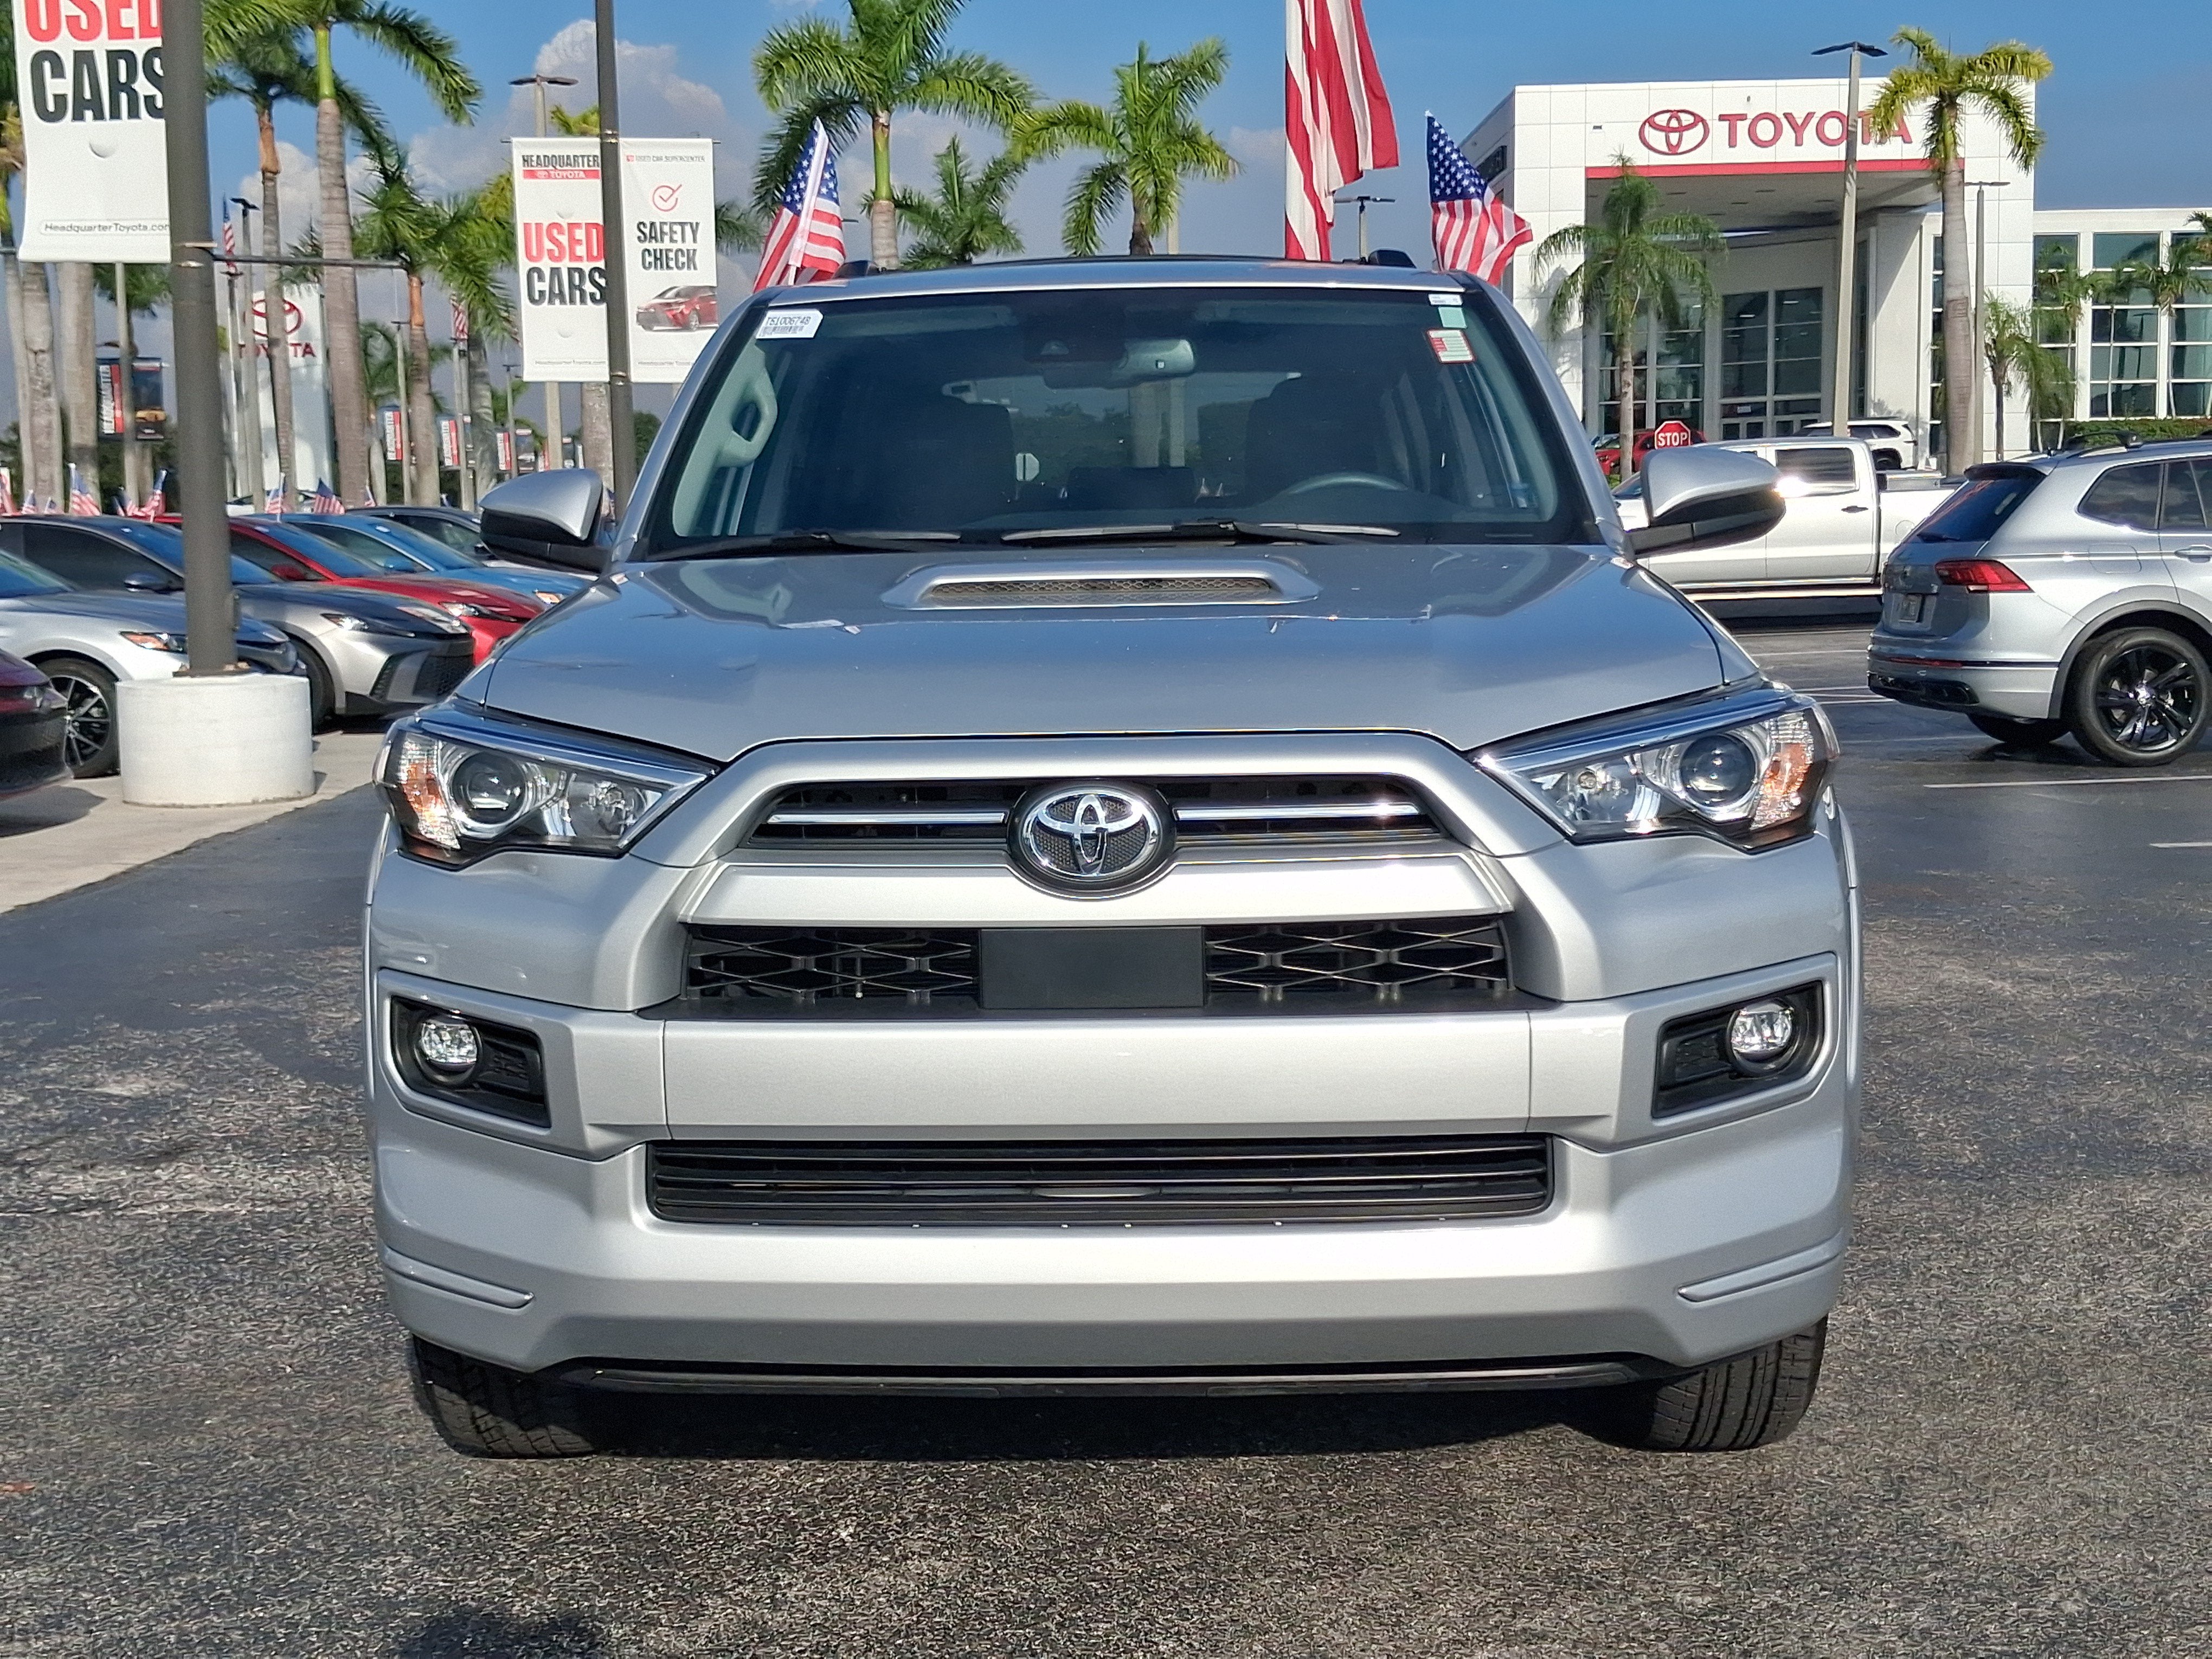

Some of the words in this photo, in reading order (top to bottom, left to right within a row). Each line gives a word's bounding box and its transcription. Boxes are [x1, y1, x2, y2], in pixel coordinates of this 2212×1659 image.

[30, 47, 164, 123] CARS
[1719, 111, 1913, 148] TOYOTA
[522, 155, 600, 169] HEADQUARTER
[523, 222, 605, 263] USED
[636, 221, 700, 243] SAFETY
[641, 248, 698, 271] CHECK
[527, 267, 607, 306] CARS
[1658, 432, 1688, 446] STOP
